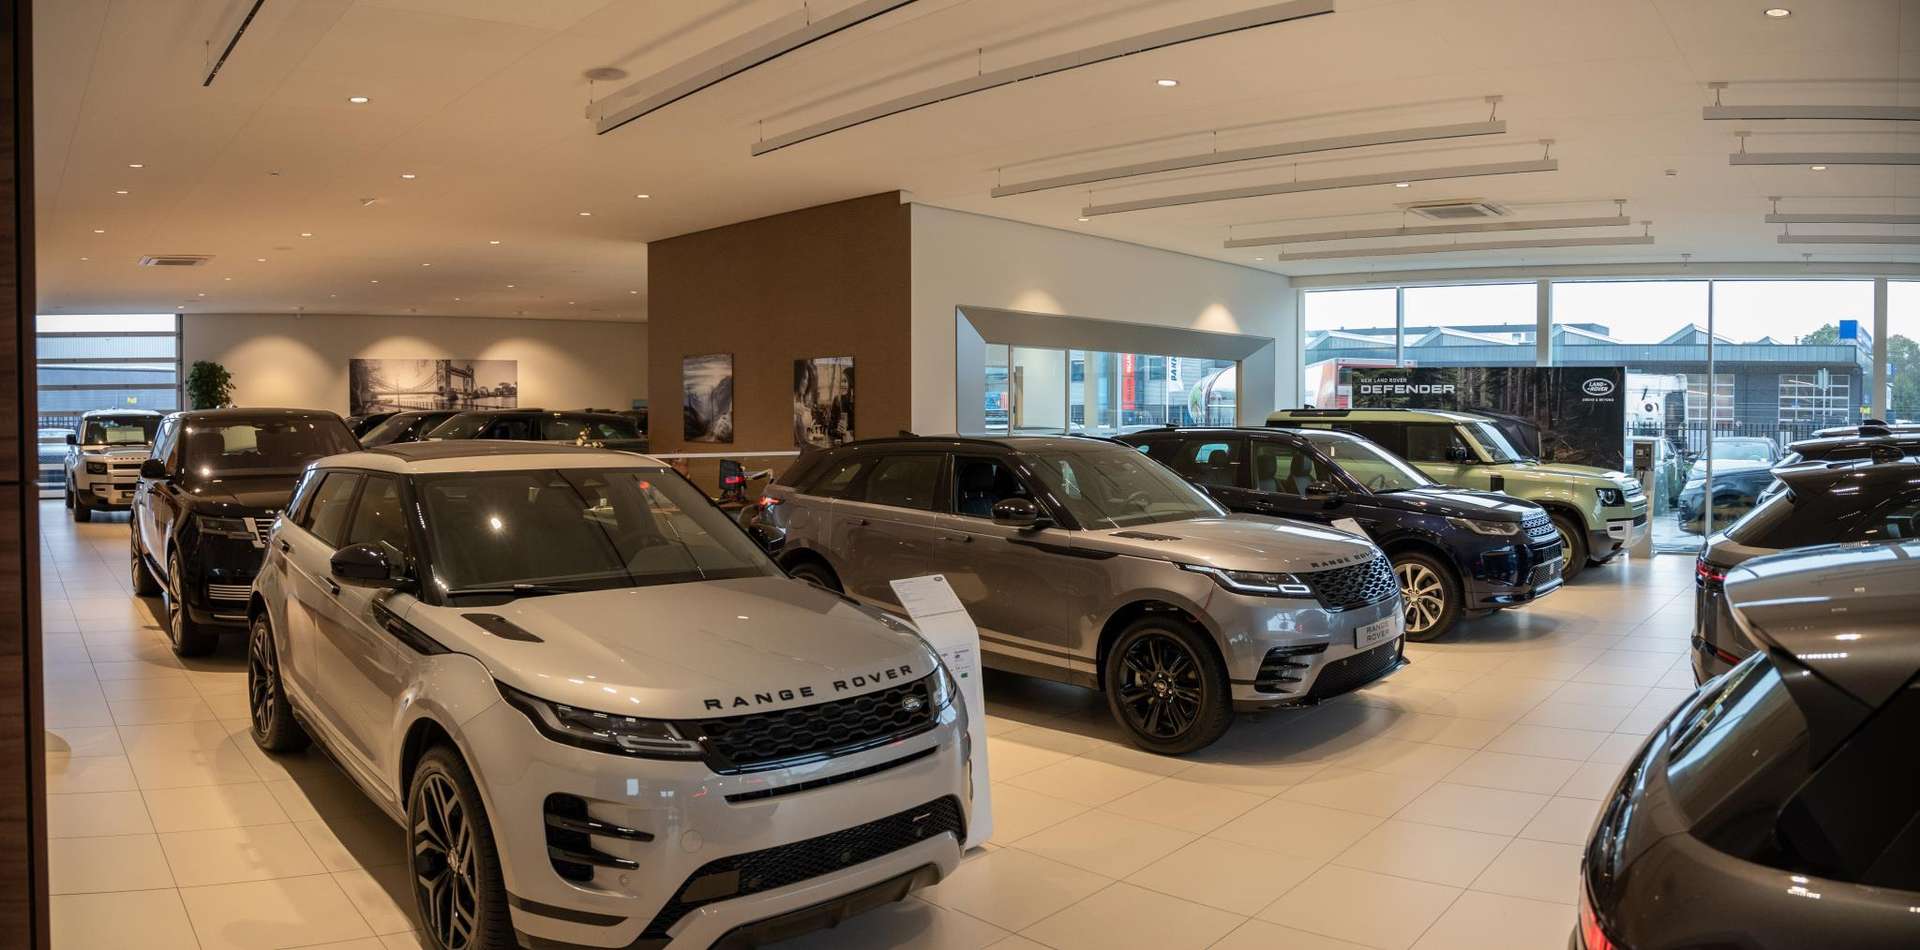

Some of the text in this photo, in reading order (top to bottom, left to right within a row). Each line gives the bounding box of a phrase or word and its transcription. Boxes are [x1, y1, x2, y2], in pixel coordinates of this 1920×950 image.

[1360, 384, 1456, 394] DEFENDER
[1311, 557, 1351, 568] RANGE
[703, 664, 913, 711] RANGE ROVER
